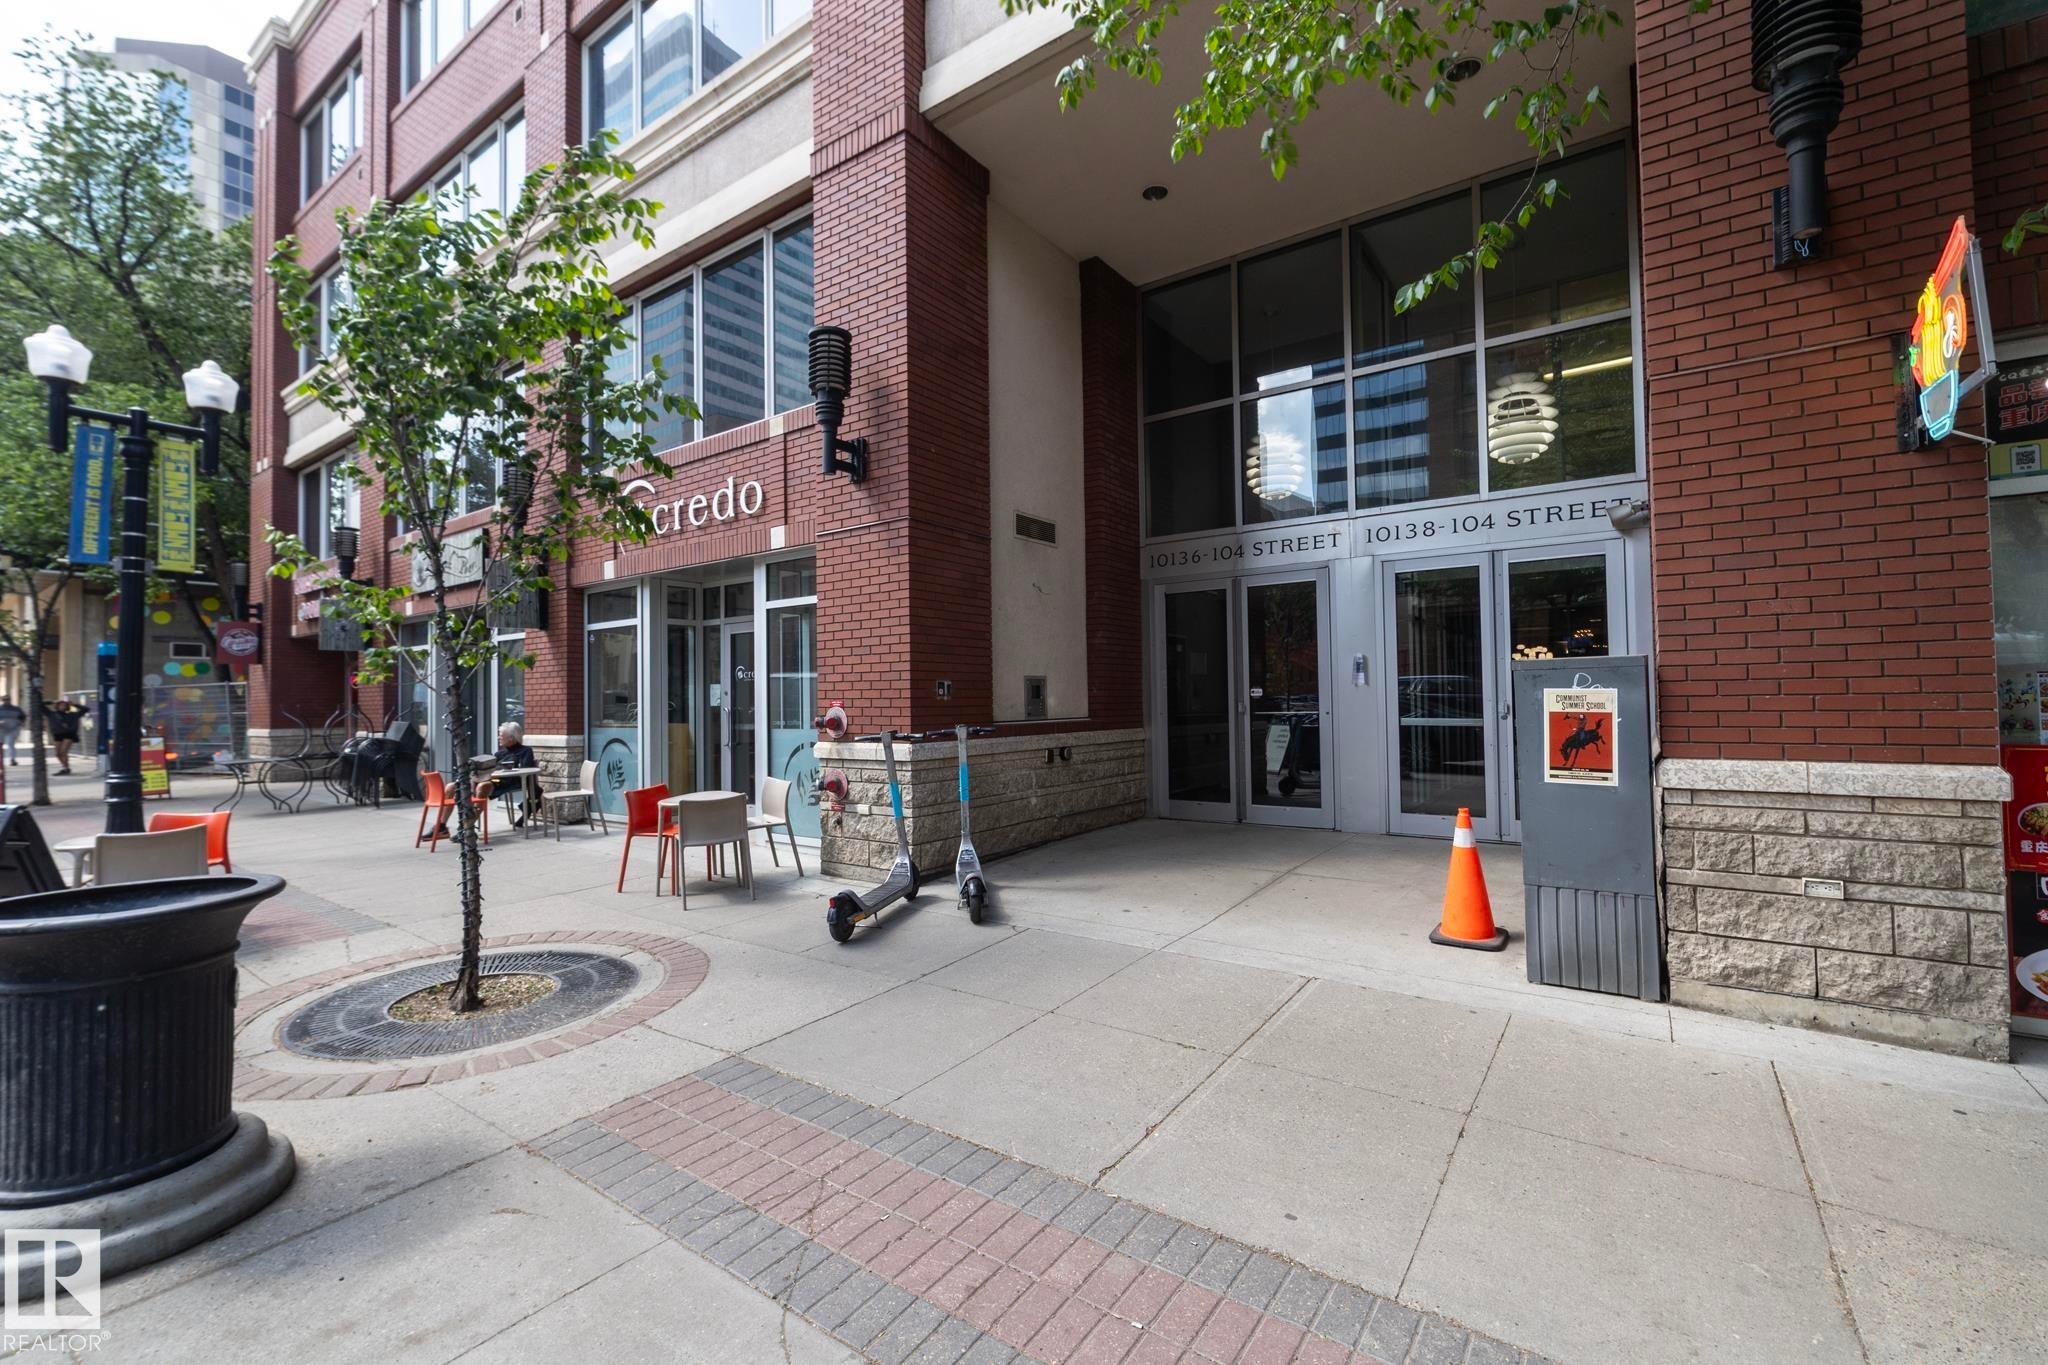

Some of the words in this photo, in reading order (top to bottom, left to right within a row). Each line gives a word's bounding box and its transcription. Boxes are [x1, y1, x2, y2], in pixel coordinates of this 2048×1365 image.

[86, 488, 101, 499] IS
[652, 475, 764, 536] credo
[82, 501, 101, 555] DIFFERENT
[1366, 513, 1496, 544] 10138-104
[1150, 545, 1245, 569] 10136-104
[1252, 532, 1342, 557] STREET
[1555, 694, 1587, 703] COMMUNIST
[1561, 702, 1585, 711] SUMMER
[1586, 701, 1607, 711] SCHOOL
